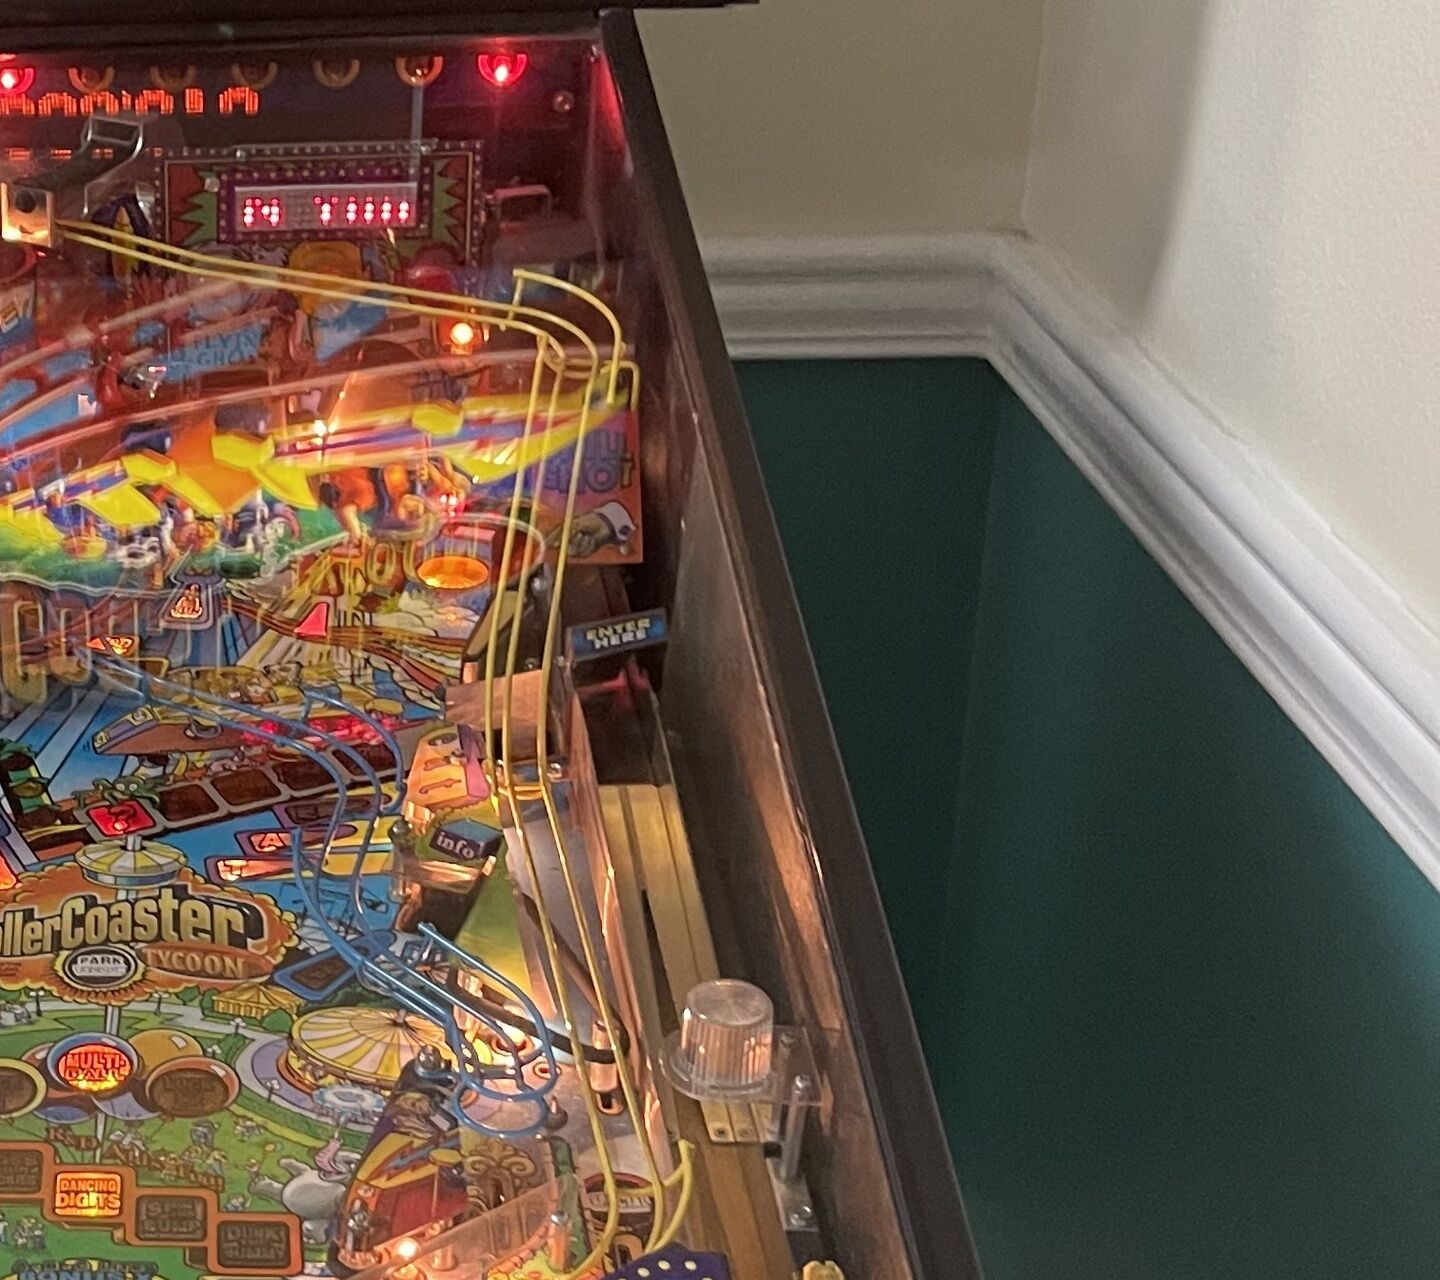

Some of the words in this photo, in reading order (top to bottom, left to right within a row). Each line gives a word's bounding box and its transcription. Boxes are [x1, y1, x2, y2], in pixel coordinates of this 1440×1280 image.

[586, 618, 651, 641] ENTER
[594, 628, 646, 649] HERE
[437, 831, 475, 858] info
[80, 955, 121, 965] PARK
[142, 947, 245, 978] TYCOON
[60, 1177, 118, 1193] DANCING
[55, 1192, 121, 1210] DIGITS
